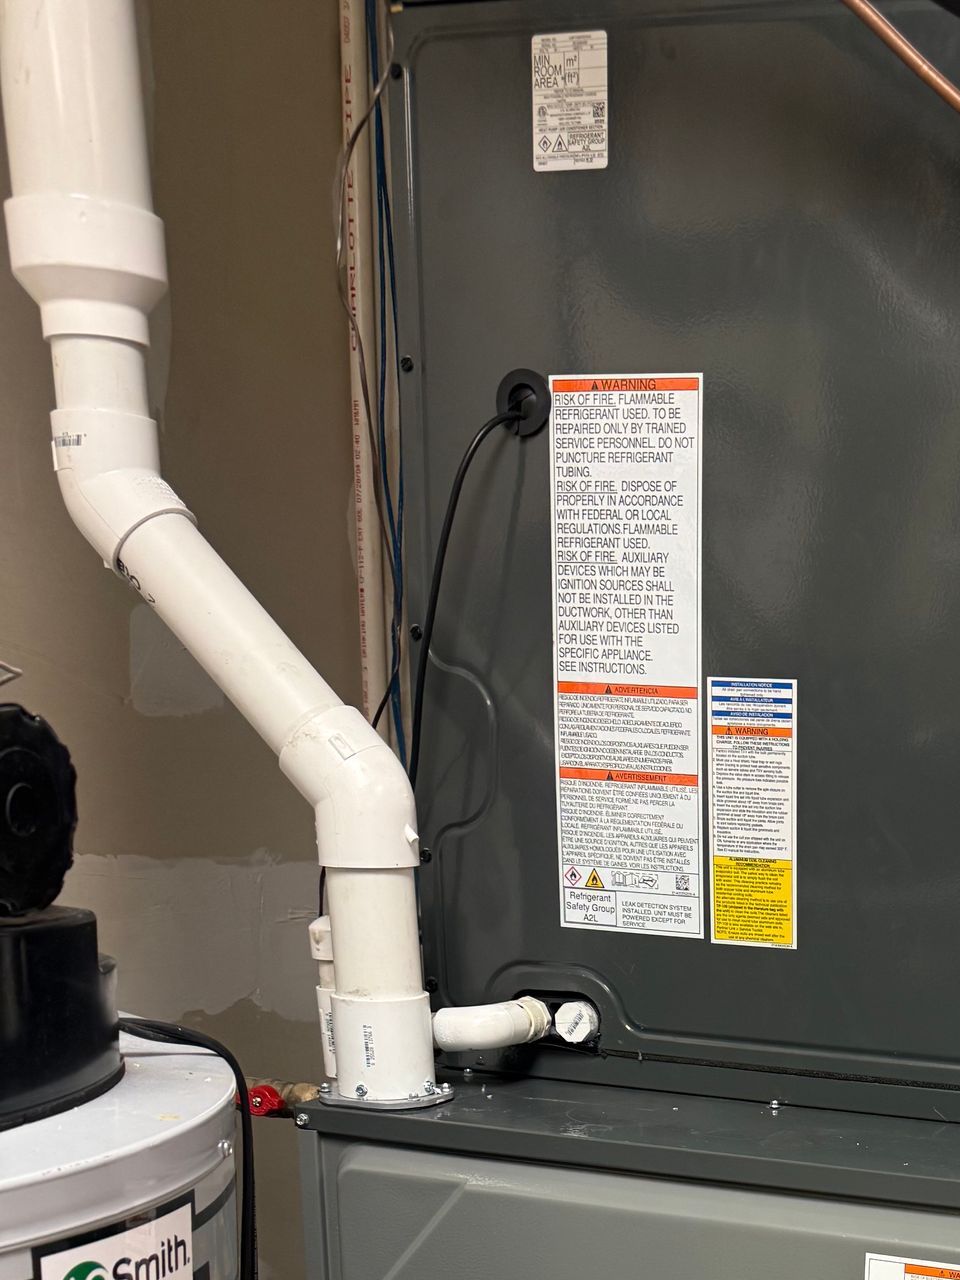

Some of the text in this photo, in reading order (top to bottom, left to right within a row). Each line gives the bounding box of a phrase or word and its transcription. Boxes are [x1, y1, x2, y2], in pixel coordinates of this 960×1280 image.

[534, 56, 550, 65] MIN
[534, 65, 562, 77] ROOM
[534, 78, 558, 88] AREA
[602, 380, 656, 390] WARNING
[555, 394, 674, 406] RISK OF FIRE. FLAMMABLE
[555, 408, 680, 420] REFRIGERANT USED. TO BE
[556, 422, 686, 434] REPAIRED ONLY BY TRAINED
[556, 437, 694, 449] SERVICE PERSONNEL. DO NOT
[556, 452, 673, 463] PUNCTURE REFRIGERANT
[556, 467, 592, 478] TUBING.
[557, 481, 677, 492] RISK OF FIRE. DISPOSE OF
[557, 495, 683, 506] PROPERLY IN ACCORDANCE
[557, 510, 671, 521] WITH FEDERAL OR LOCAL
[558, 538, 650, 549] REFRIGERANT USED.
[558, 552, 669, 564] RISK OF FIRE. AUXILIARY
[558, 566, 665, 578] DEVICES WHICH MAY BE
[558, 580, 674, 592] IGNITION SOURCES SHALL
[558, 593, 673, 606] NOT BE INSTALLED IN THE
[558, 607, 673, 620] DUCTWORK, OTHER THAN
[559, 620, 679, 634] AUXILIARY DEVICES LISTED
[559, 634, 643, 646] FOR USE WITH THE
[559, 648, 652, 661] SPECIFIC APPLIANCE.
[559, 662, 647, 674] SEE INSTRUCTIONS.
[615, 686, 658, 694] ADVERTENCIA
[615, 772, 667, 781] AVERTISSEMENT
[570, 892, 611, 903] Refrigerant
[566, 902, 615, 914] Safety Group
[637, 902, 668, 910] DETECTION
[583, 914, 598, 922] A2L
